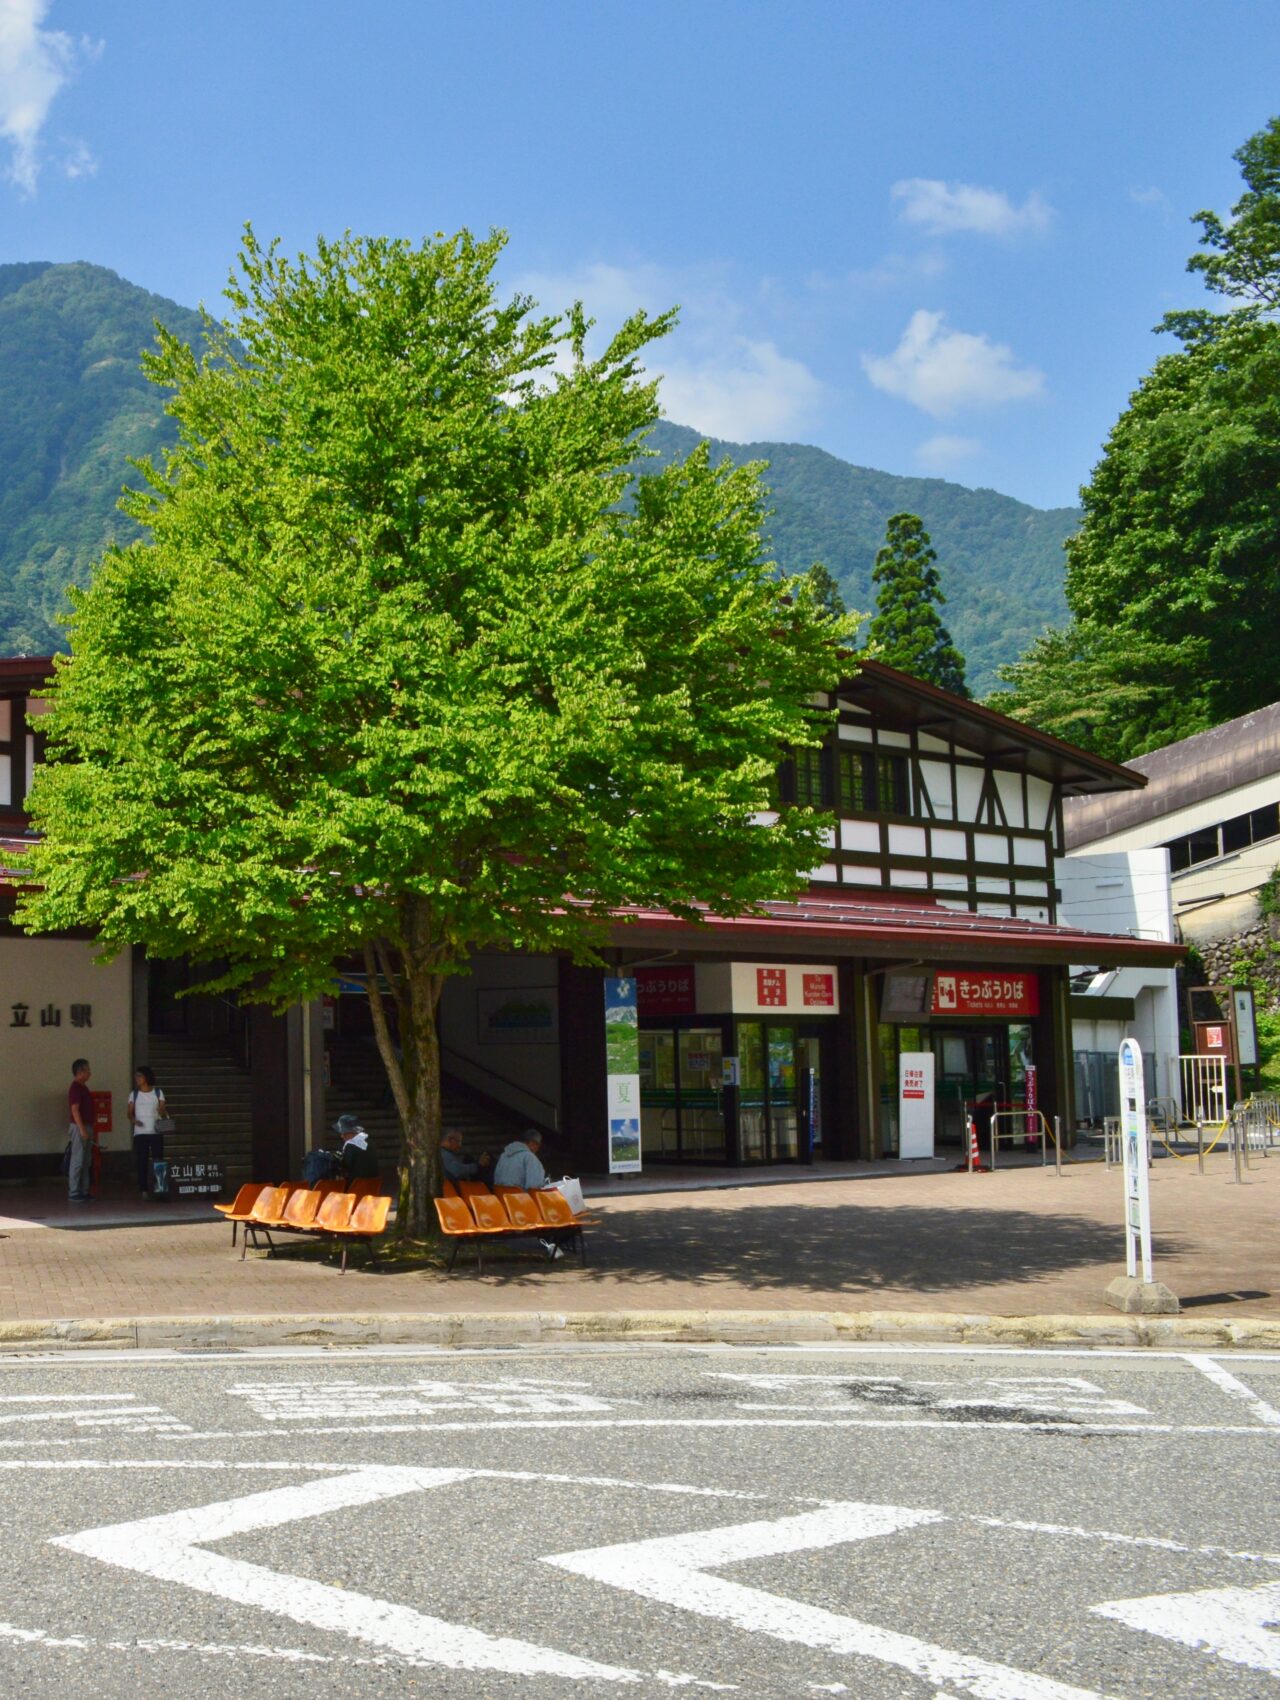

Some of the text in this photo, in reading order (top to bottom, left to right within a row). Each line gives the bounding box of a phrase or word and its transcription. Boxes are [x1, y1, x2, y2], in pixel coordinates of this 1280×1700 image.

[636, 977, 690, 994] っぷうりば
[959, 979, 1025, 1000] きっぷうりば
[9, 1002, 93, 1028] 立山駅
[616, 1082, 631, 1104] 夏
[170, 1164, 206, 1178] 立山駅
